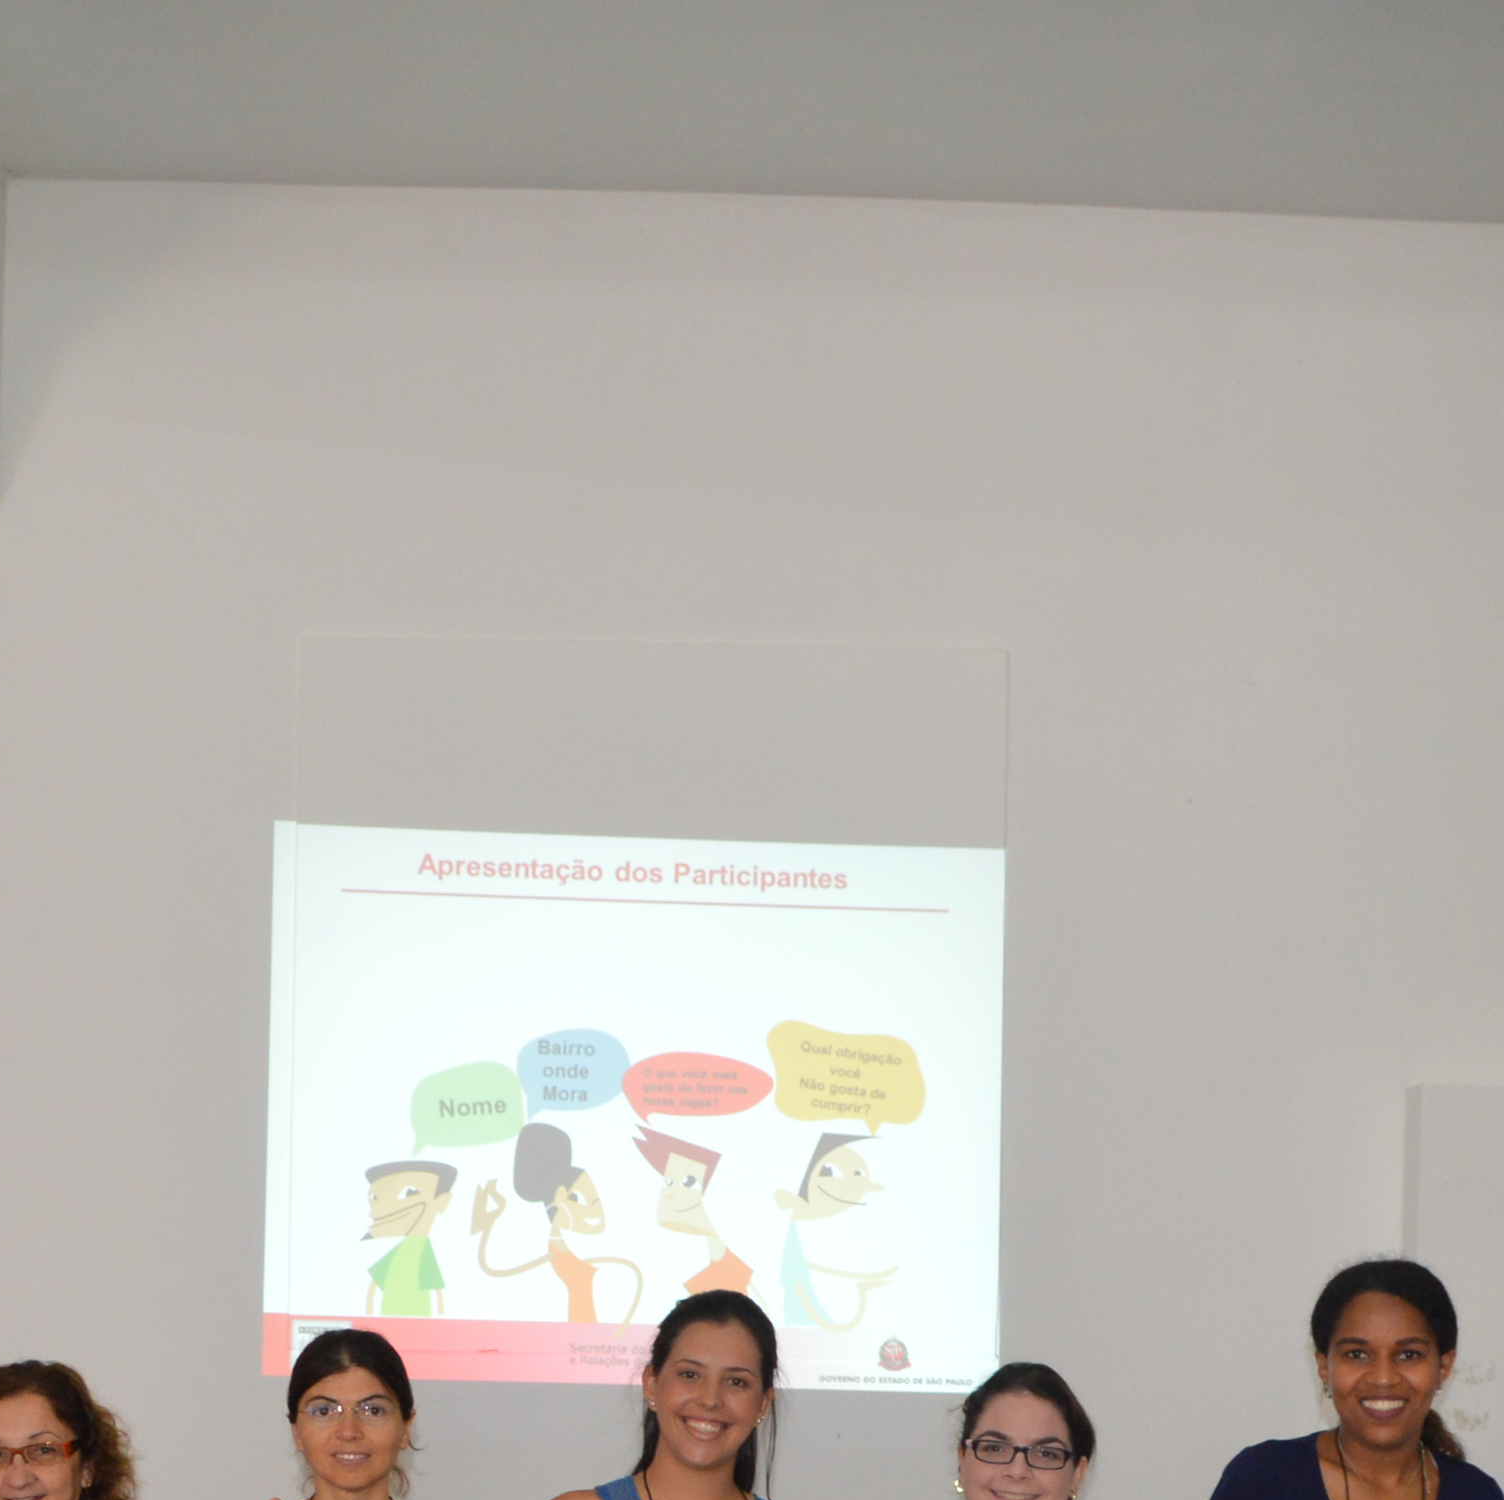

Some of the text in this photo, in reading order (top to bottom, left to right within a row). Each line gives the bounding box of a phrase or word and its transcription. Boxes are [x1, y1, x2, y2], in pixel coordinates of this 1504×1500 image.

[417, 853, 848, 891] Apresentação dos Participantes
[537, 1039, 596, 1057] Bairro
[801, 1040, 902, 1066] Qual obrigação
[542, 1063, 589, 1079] onde
[643, 1067, 653, 1077] O
[656, 1069, 676, 1079] que
[830, 1066, 861, 1079] você
[542, 1085, 588, 1102] Mora
[799, 1077, 887, 1100] Não gosta de
[439, 1098, 507, 1118] Nome
[811, 1098, 871, 1115] cumprir?
